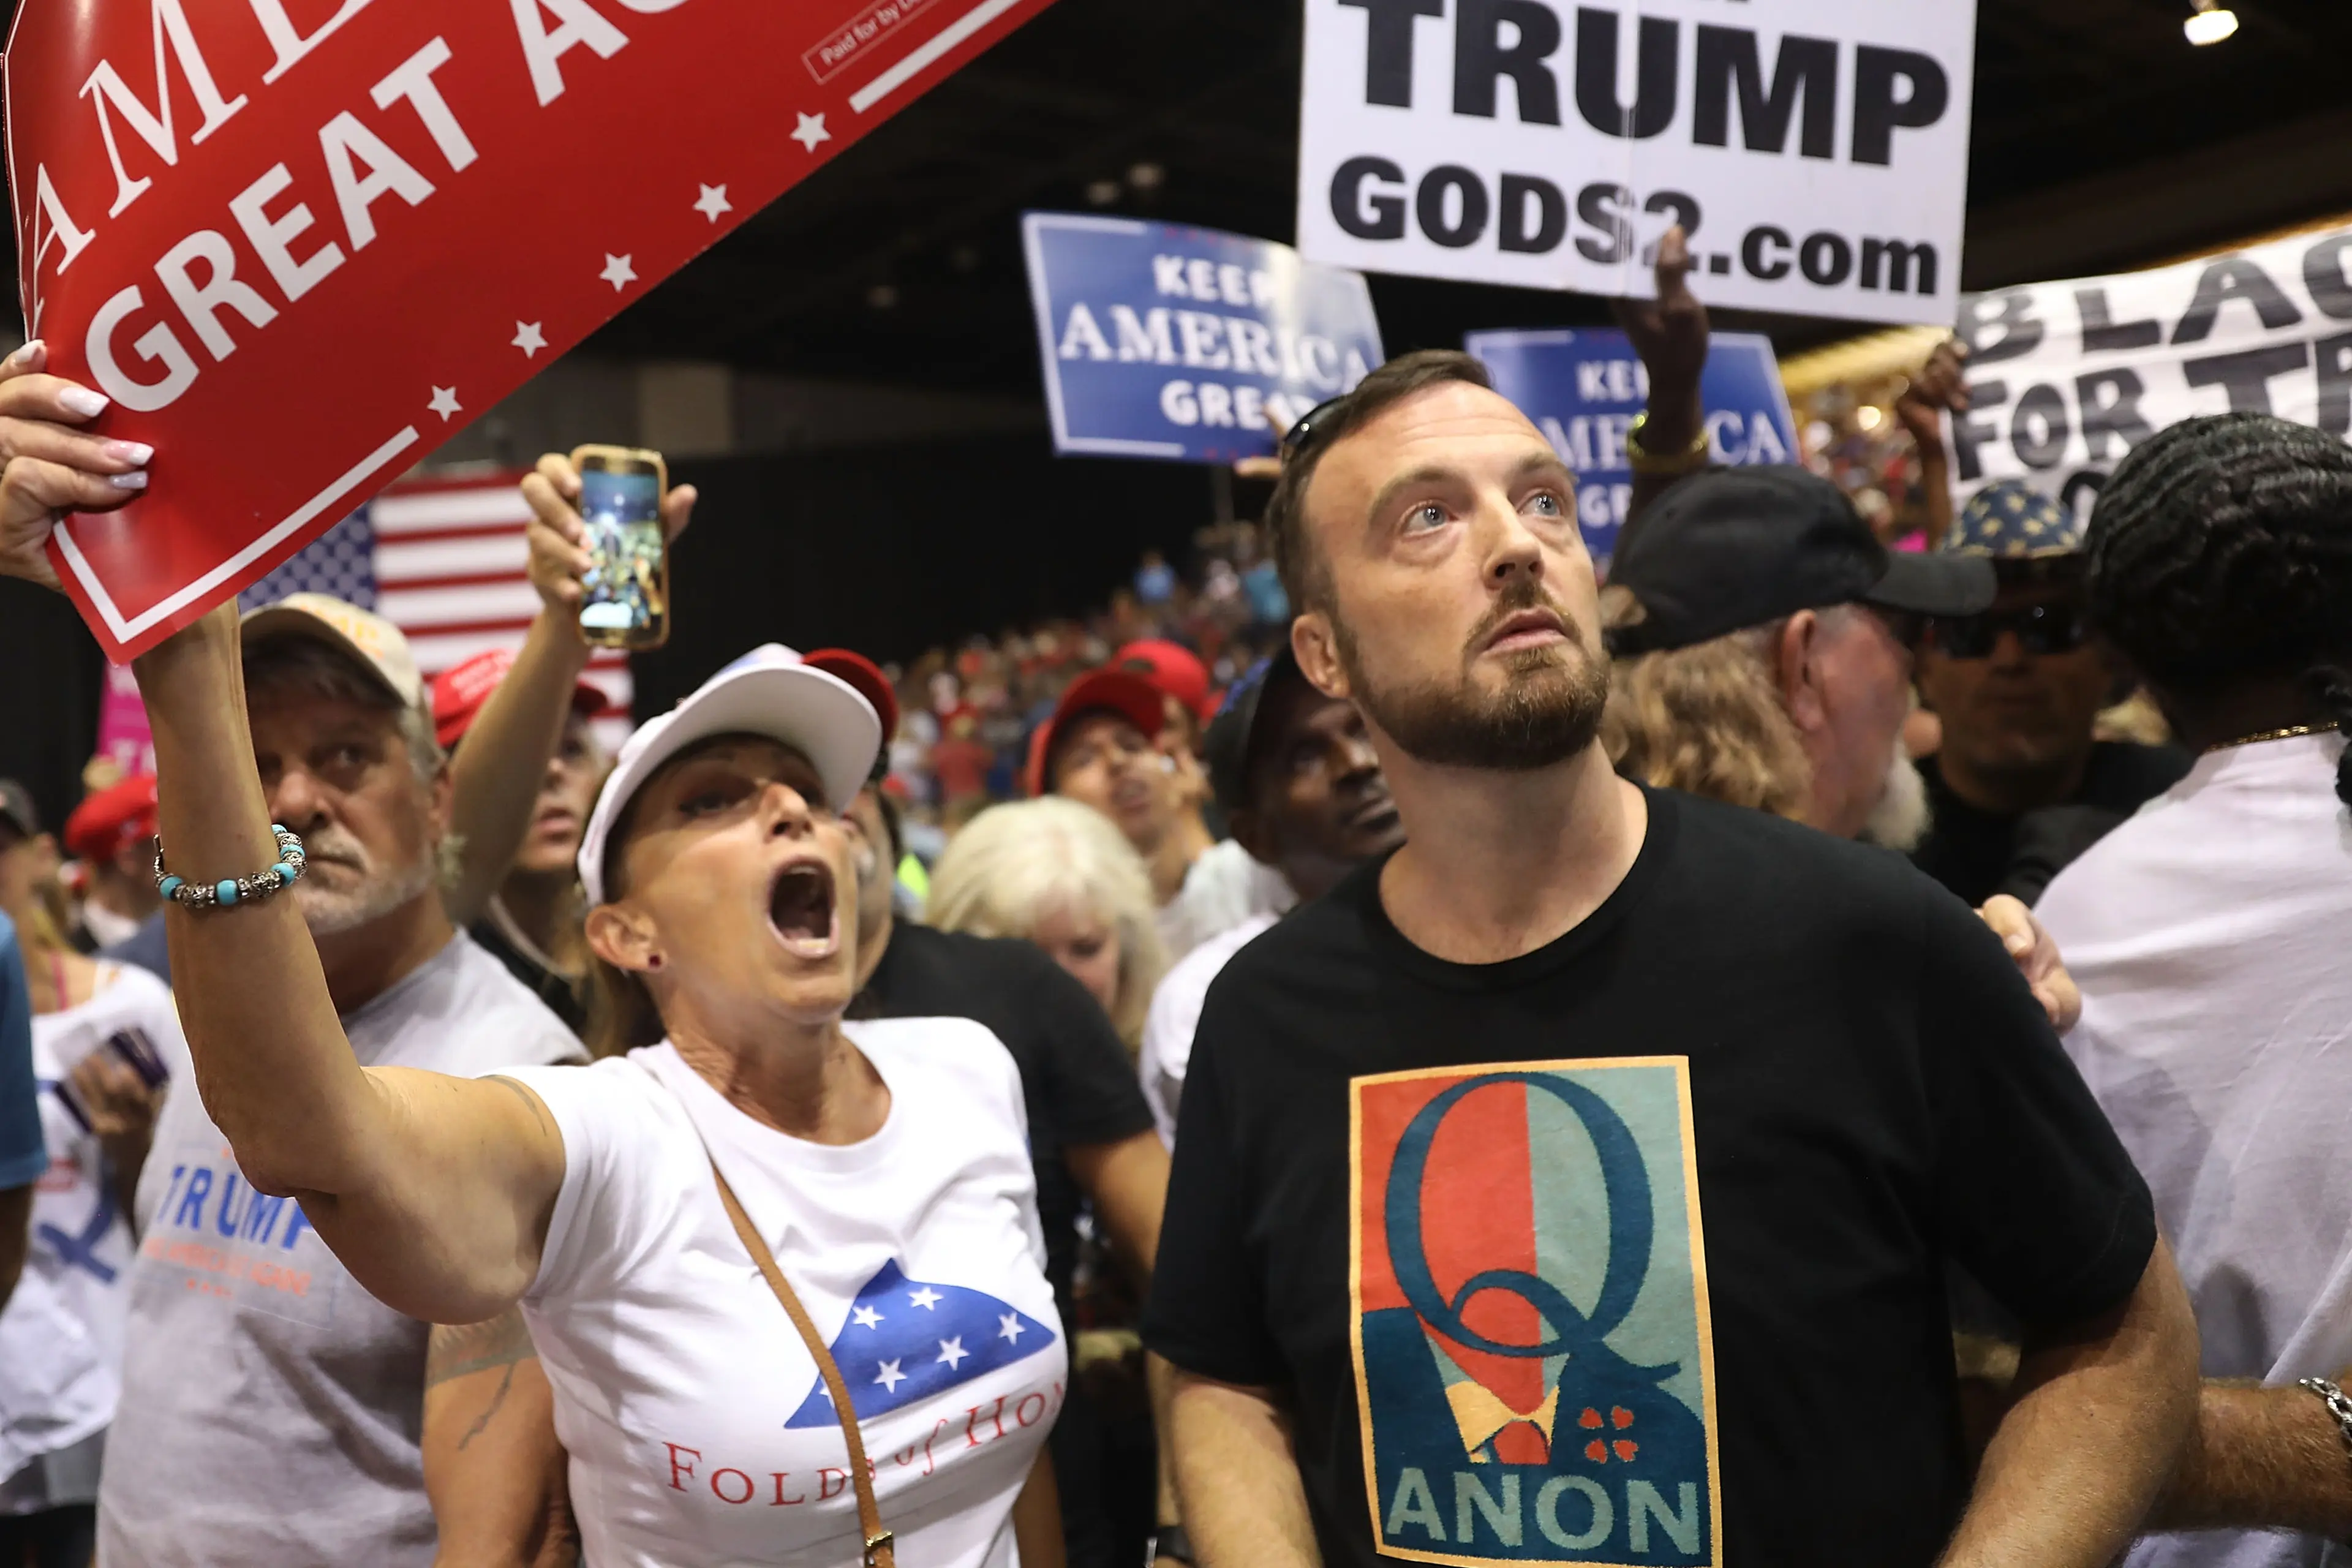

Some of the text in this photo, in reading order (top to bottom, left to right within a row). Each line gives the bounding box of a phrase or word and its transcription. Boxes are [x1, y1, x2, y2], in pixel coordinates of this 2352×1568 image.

[819, 32, 858, 66] Paid
[1338, 0, 1950, 166] TRUMP
[85, 0, 689, 412] GREAT A
[1329, 155, 1937, 295] GODS2.com
[1058, 301, 1372, 394] AMERICA
[1951, 368, 2156, 481] FOR
[1384, 1071, 1681, 1382] Q
[1386, 1468, 1700, 1555] ANON
